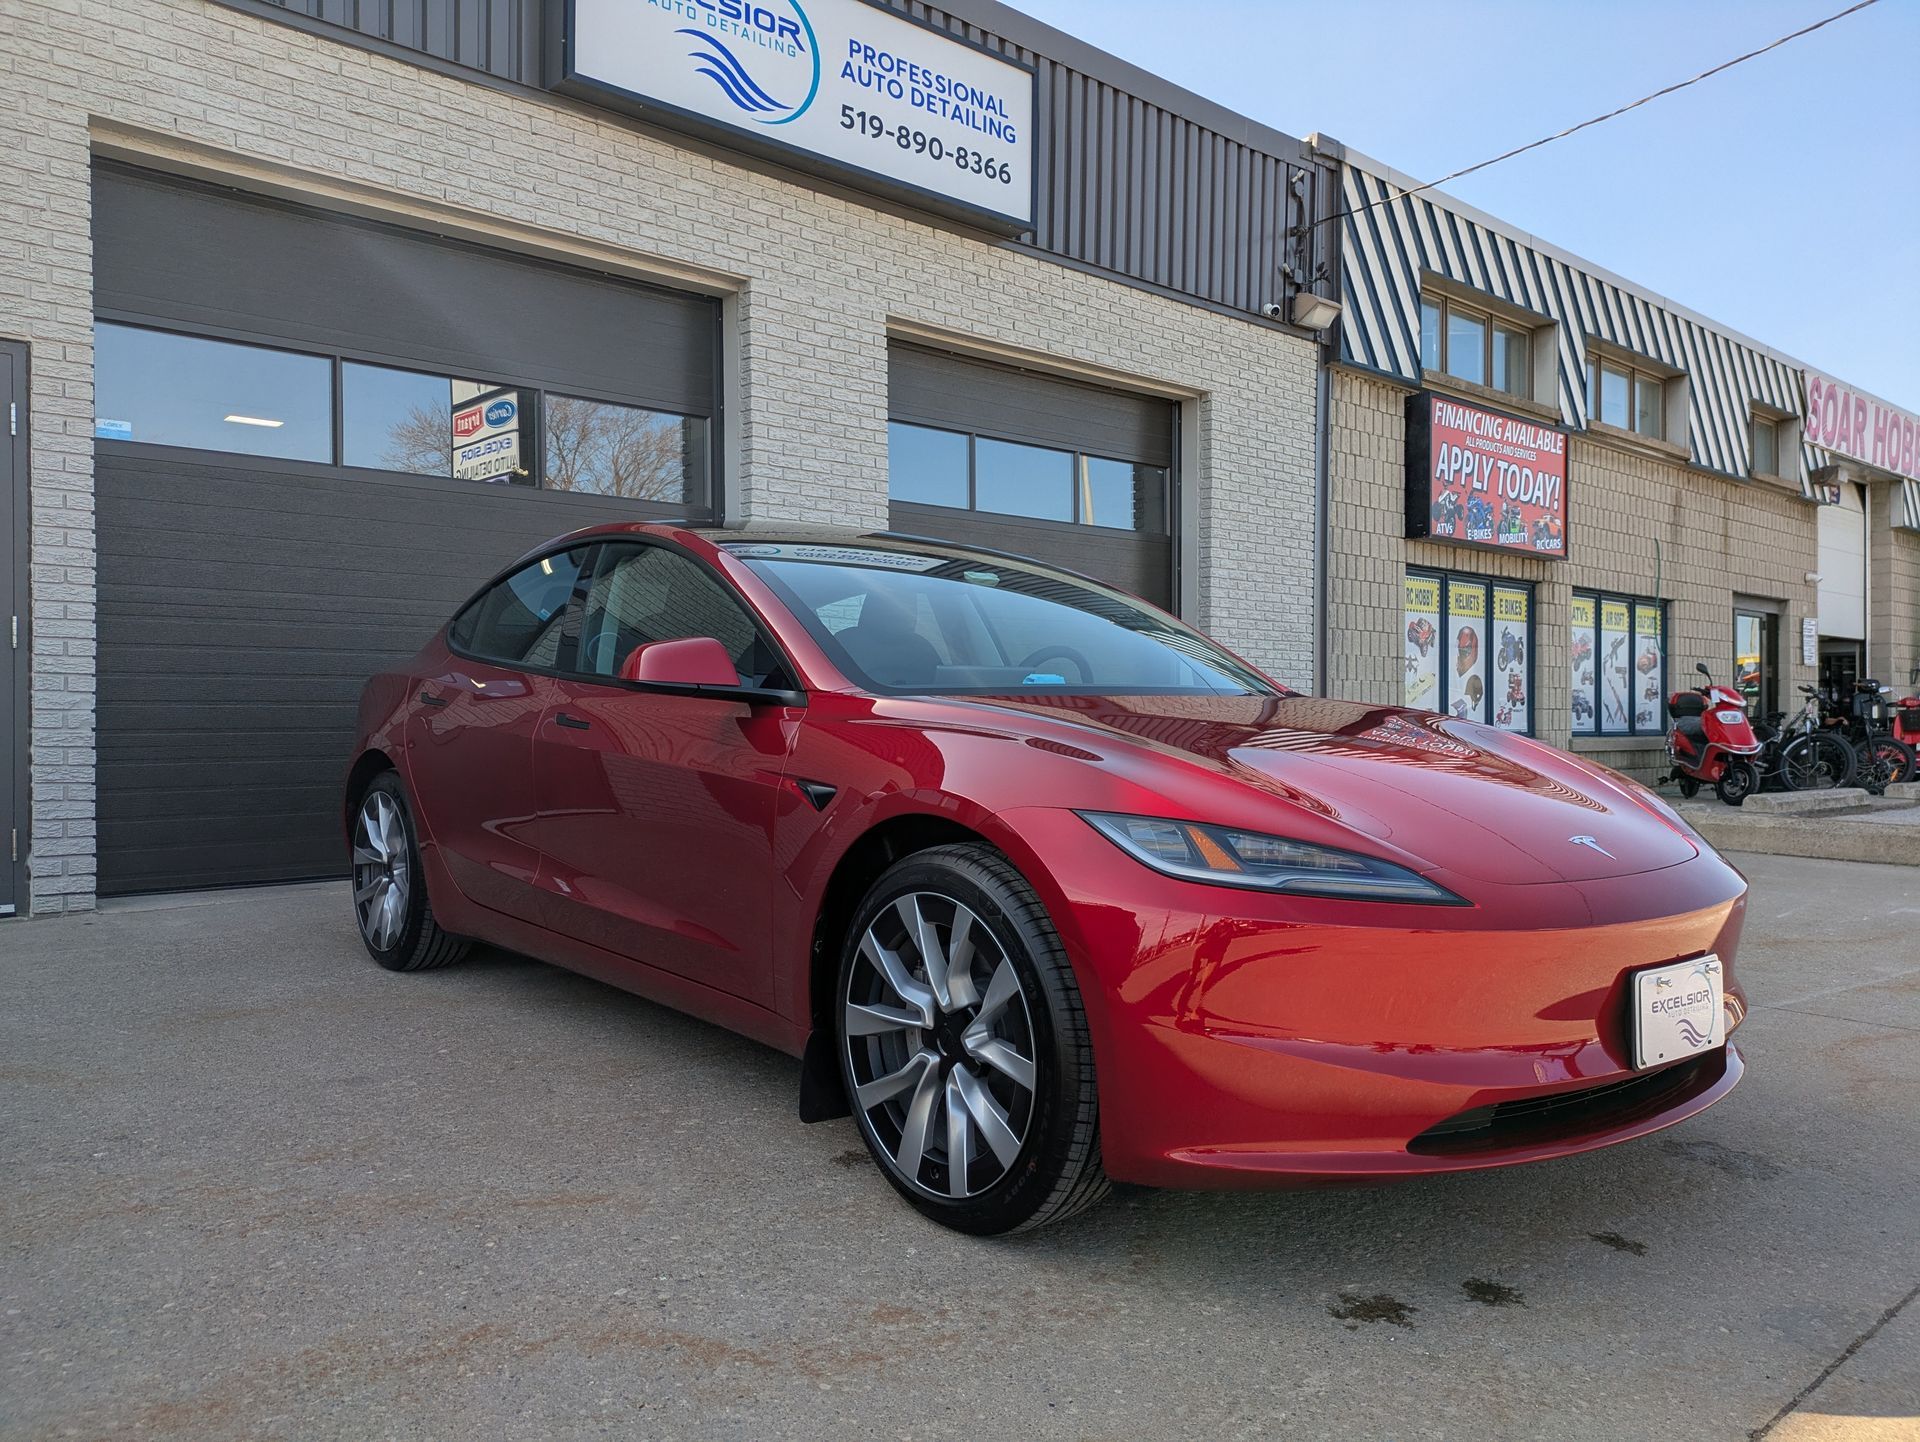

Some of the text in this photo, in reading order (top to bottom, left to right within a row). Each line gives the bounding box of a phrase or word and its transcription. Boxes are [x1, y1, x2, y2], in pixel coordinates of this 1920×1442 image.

[707, 13, 796, 58] DETAILING
[848, 38, 1009, 119] PROFESSIONAL
[840, 60, 1017, 144] AUTO DETAILING
[839, 103, 1012, 185] 519-890-8366
[1434, 402, 1563, 455] FINANCING AVAILABLE
[1807, 376, 1868, 460] SOAR
[1465, 435, 1537, 461] ALL PRODUCTS AND SERVICES
[1435, 442, 1561, 511] APPLY TODAY!
[1436, 522, 1453, 535] ATVs
[1467, 528, 1492, 540] E-BIKES
[1499, 532, 1529, 544] MOBILITY
[1536, 538, 1562, 550] RC CARS
[1414, 588, 1434, 607] HOBBY
[1454, 593, 1480, 612] HELMETS
[1499, 598, 1523, 616] E BIKES
[1651, 989, 1711, 1014] EXCELSIOR
